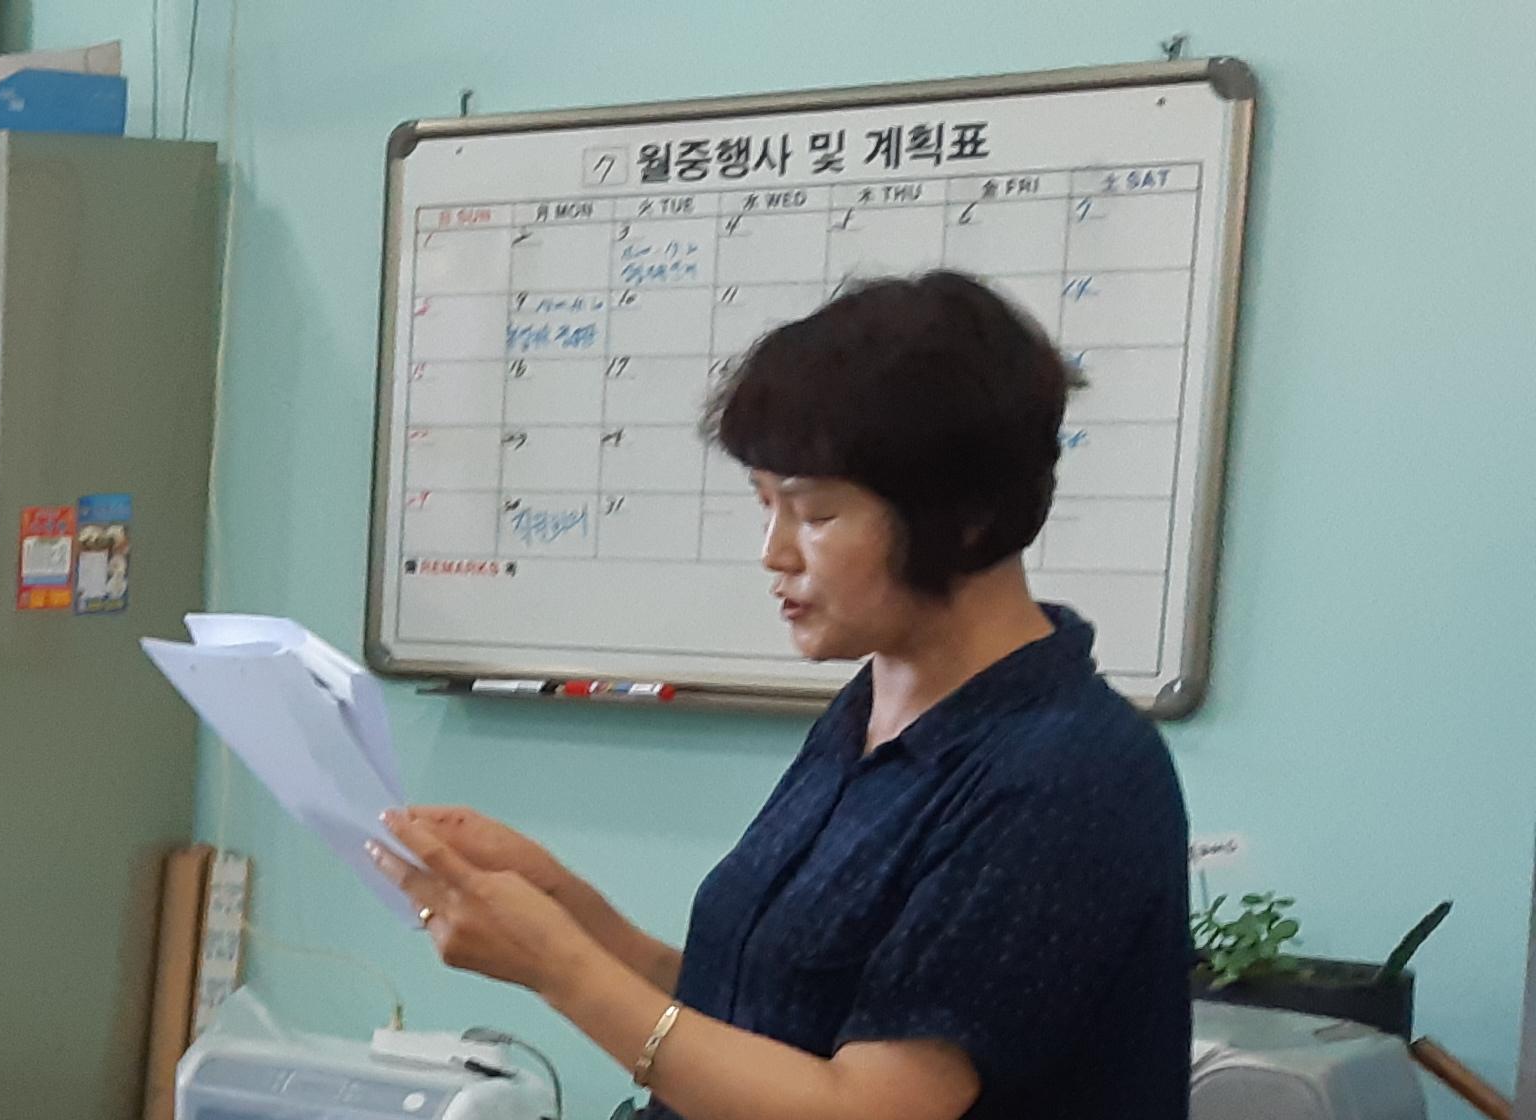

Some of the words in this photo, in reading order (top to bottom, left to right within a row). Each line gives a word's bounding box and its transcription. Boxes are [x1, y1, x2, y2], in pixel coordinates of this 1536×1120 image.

[636, 132, 793, 184] 월중행사
[810, 128, 846, 173] 및
[864, 120, 990, 168] 계획표
[594, 153, 615, 184] 7
[1004, 177, 1041, 195] FRI
[1125, 170, 1170, 188] SAT
[765, 190, 809, 210] WED
[881, 183, 924, 203] THU
[553, 202, 594, 220] MON
[659, 196, 694, 215] TUE
[456, 208, 492, 224] SUN
